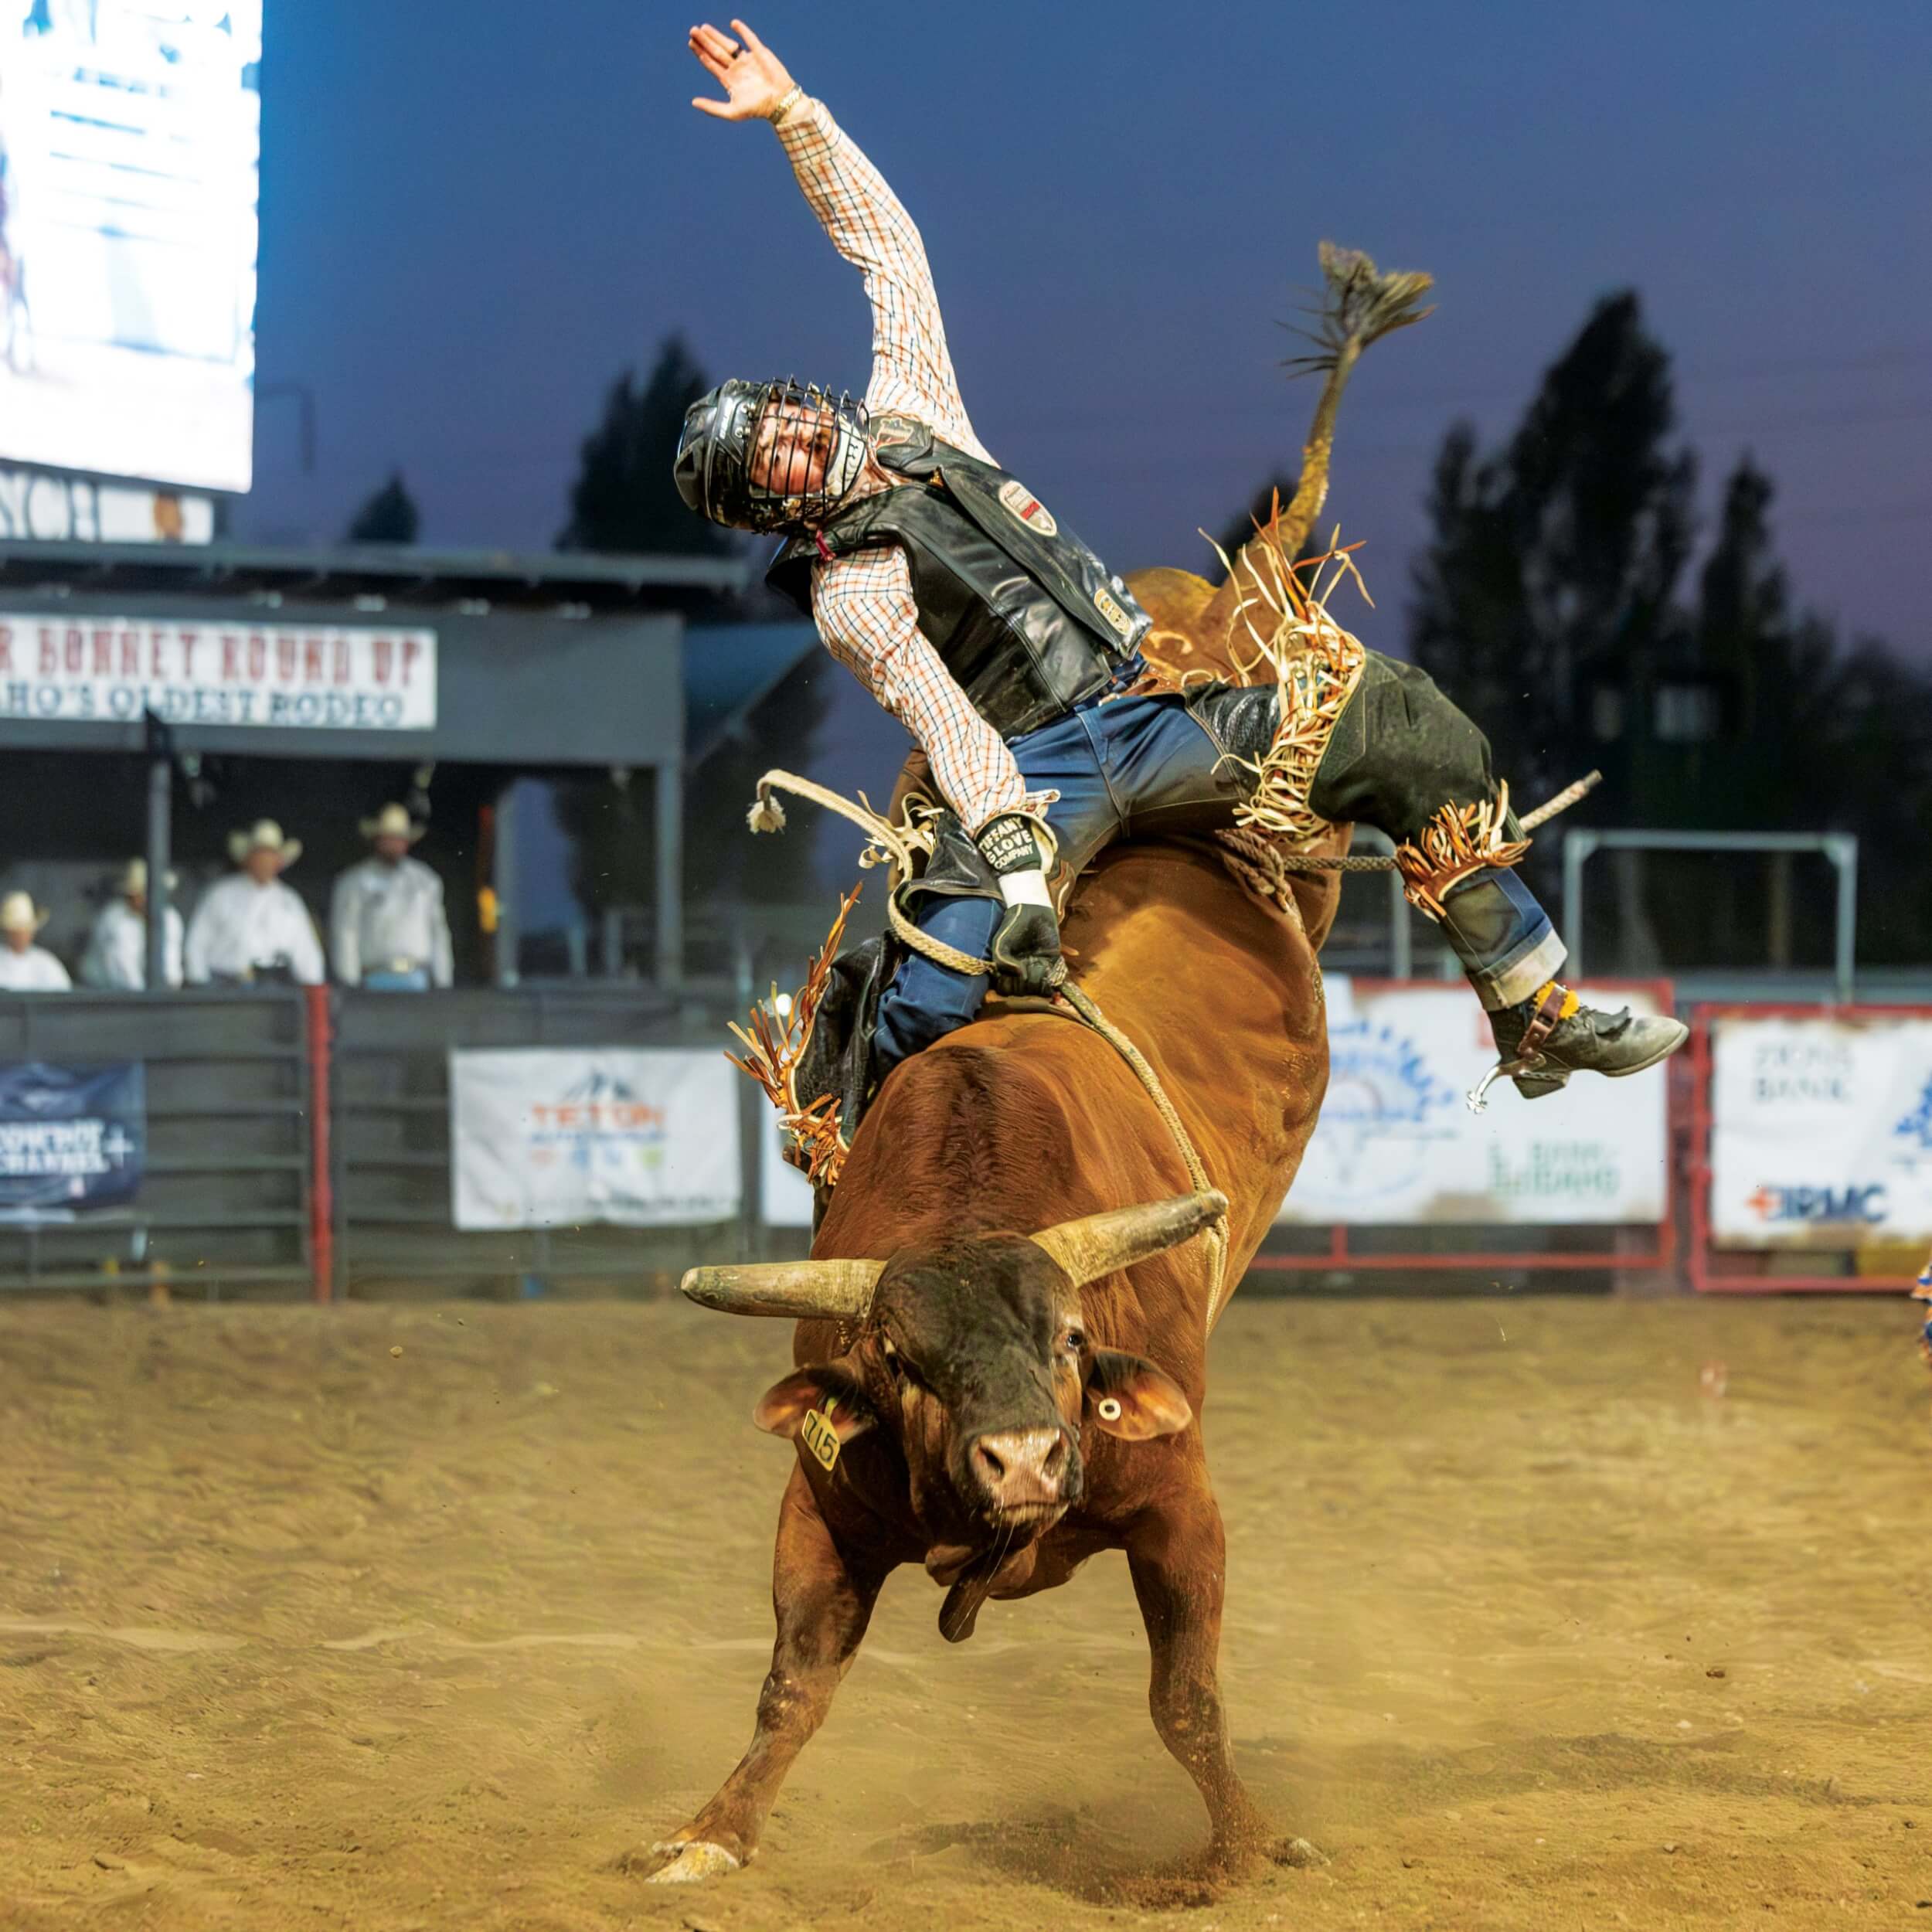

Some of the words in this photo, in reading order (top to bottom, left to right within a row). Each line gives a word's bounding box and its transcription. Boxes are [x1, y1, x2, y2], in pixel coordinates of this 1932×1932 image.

[39, 628, 198, 679] BONNET
[222, 634, 349, 685] ROUND
[372, 639, 420, 687] UP
[270, 689, 403, 726] RODEO
[978, 816, 1024, 854] TIFFANY
[986, 830, 1032, 864] GLOVE
[994, 843, 1033, 869] COMPANY
[805, 1412, 837, 1463] 715
